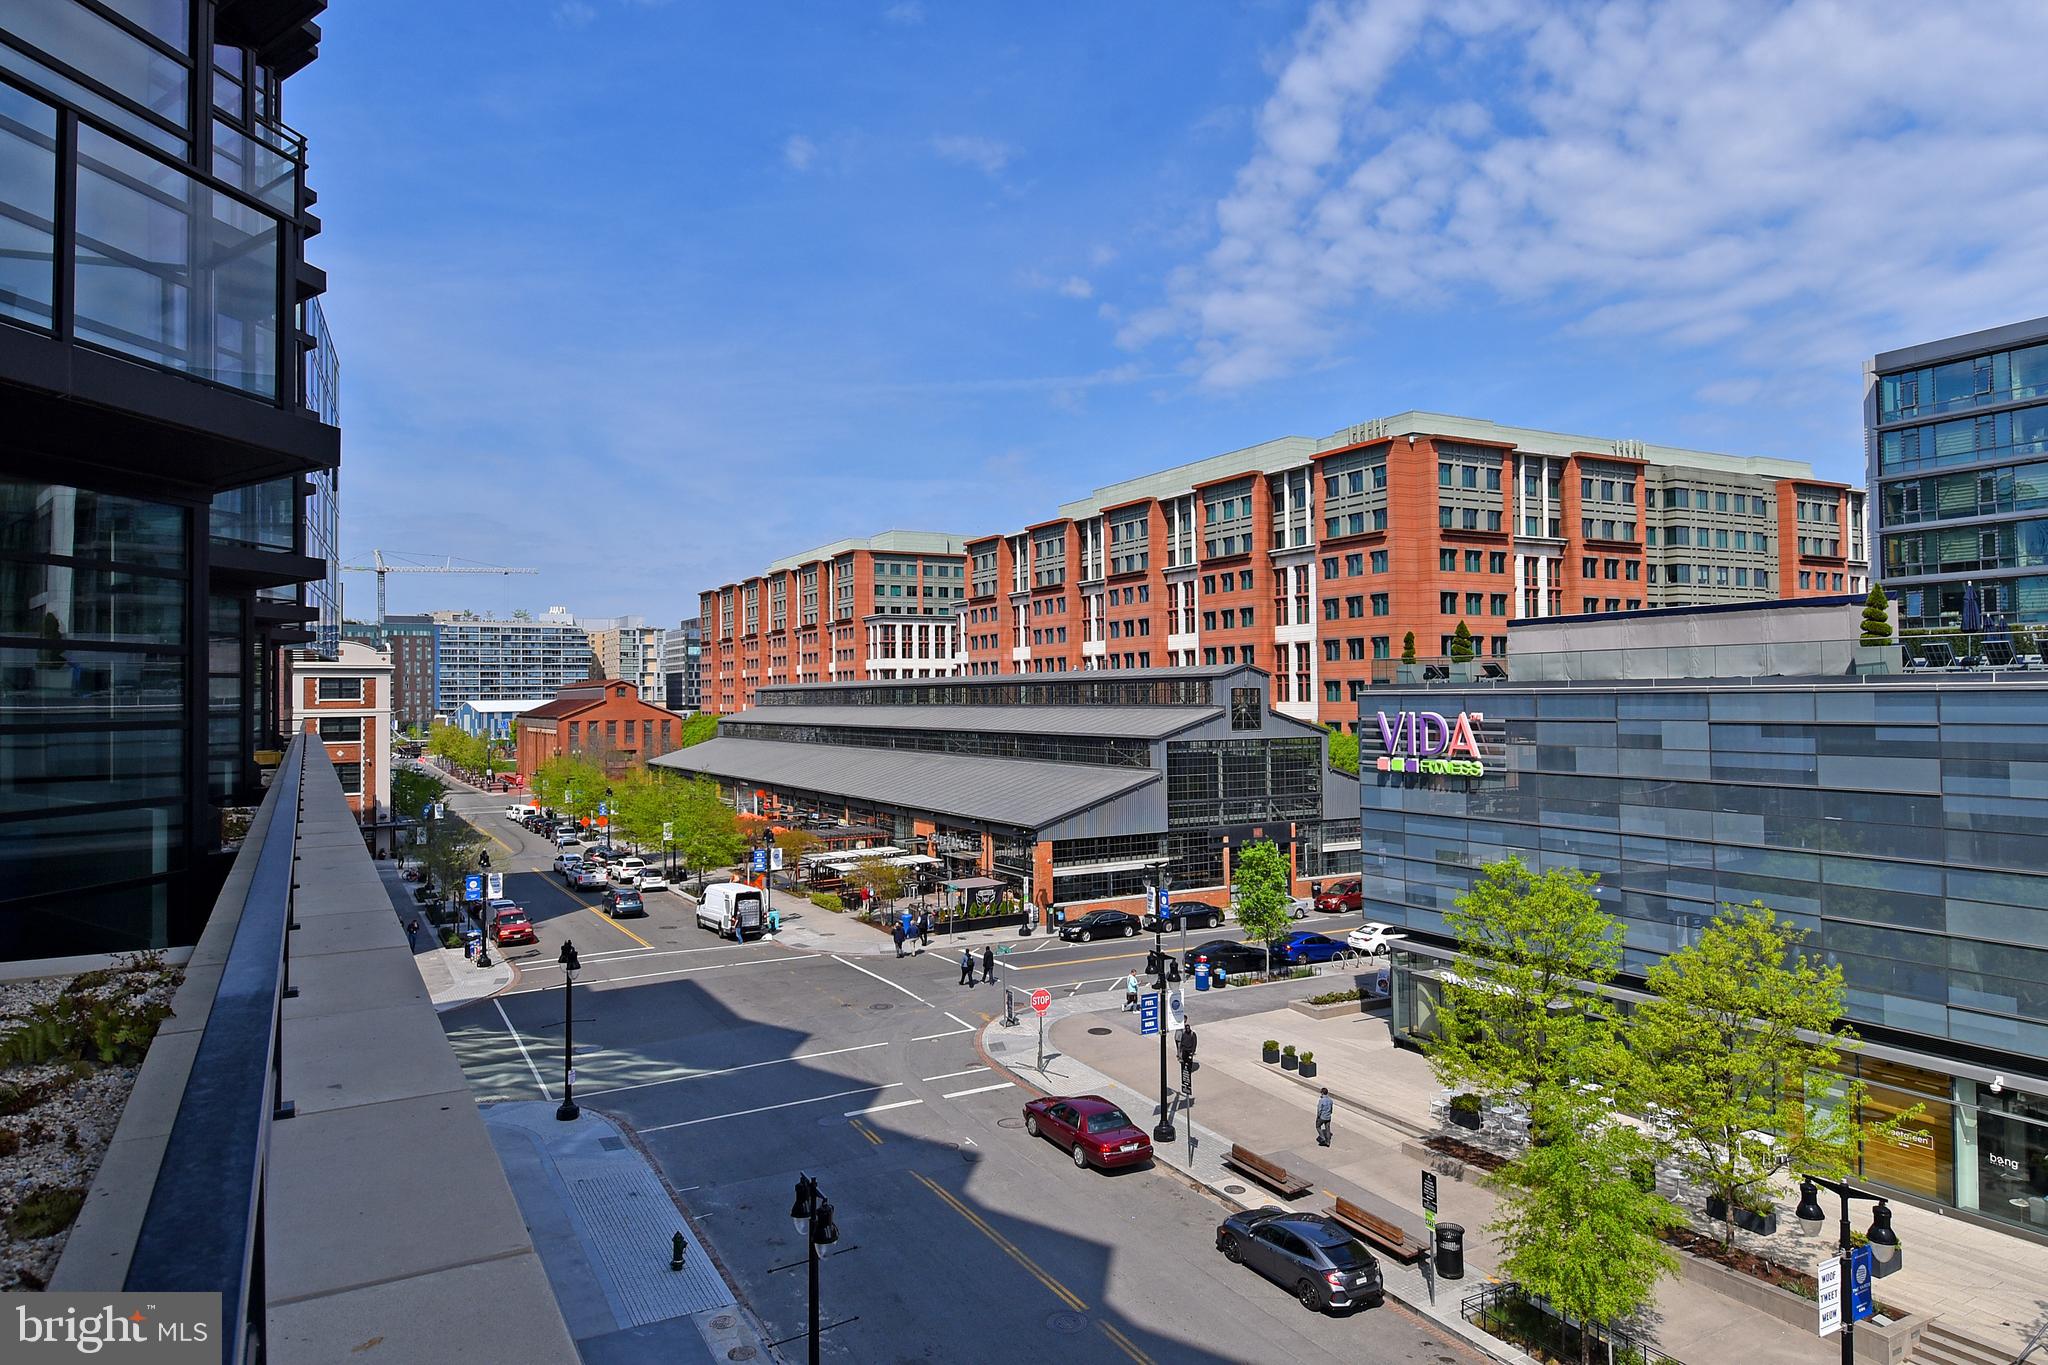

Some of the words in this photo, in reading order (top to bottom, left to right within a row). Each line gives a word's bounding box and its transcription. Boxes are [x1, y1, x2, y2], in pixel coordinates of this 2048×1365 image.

[1377, 711, 1482, 759] VIDA
[1032, 996, 1050, 1005] STOP
[1989, 1152, 2019, 1170] bang
[1821, 1270, 1837, 1284] WOOF
[1820, 1289, 1838, 1304] TWEET
[1822, 1309, 1837, 1322] MEOW
